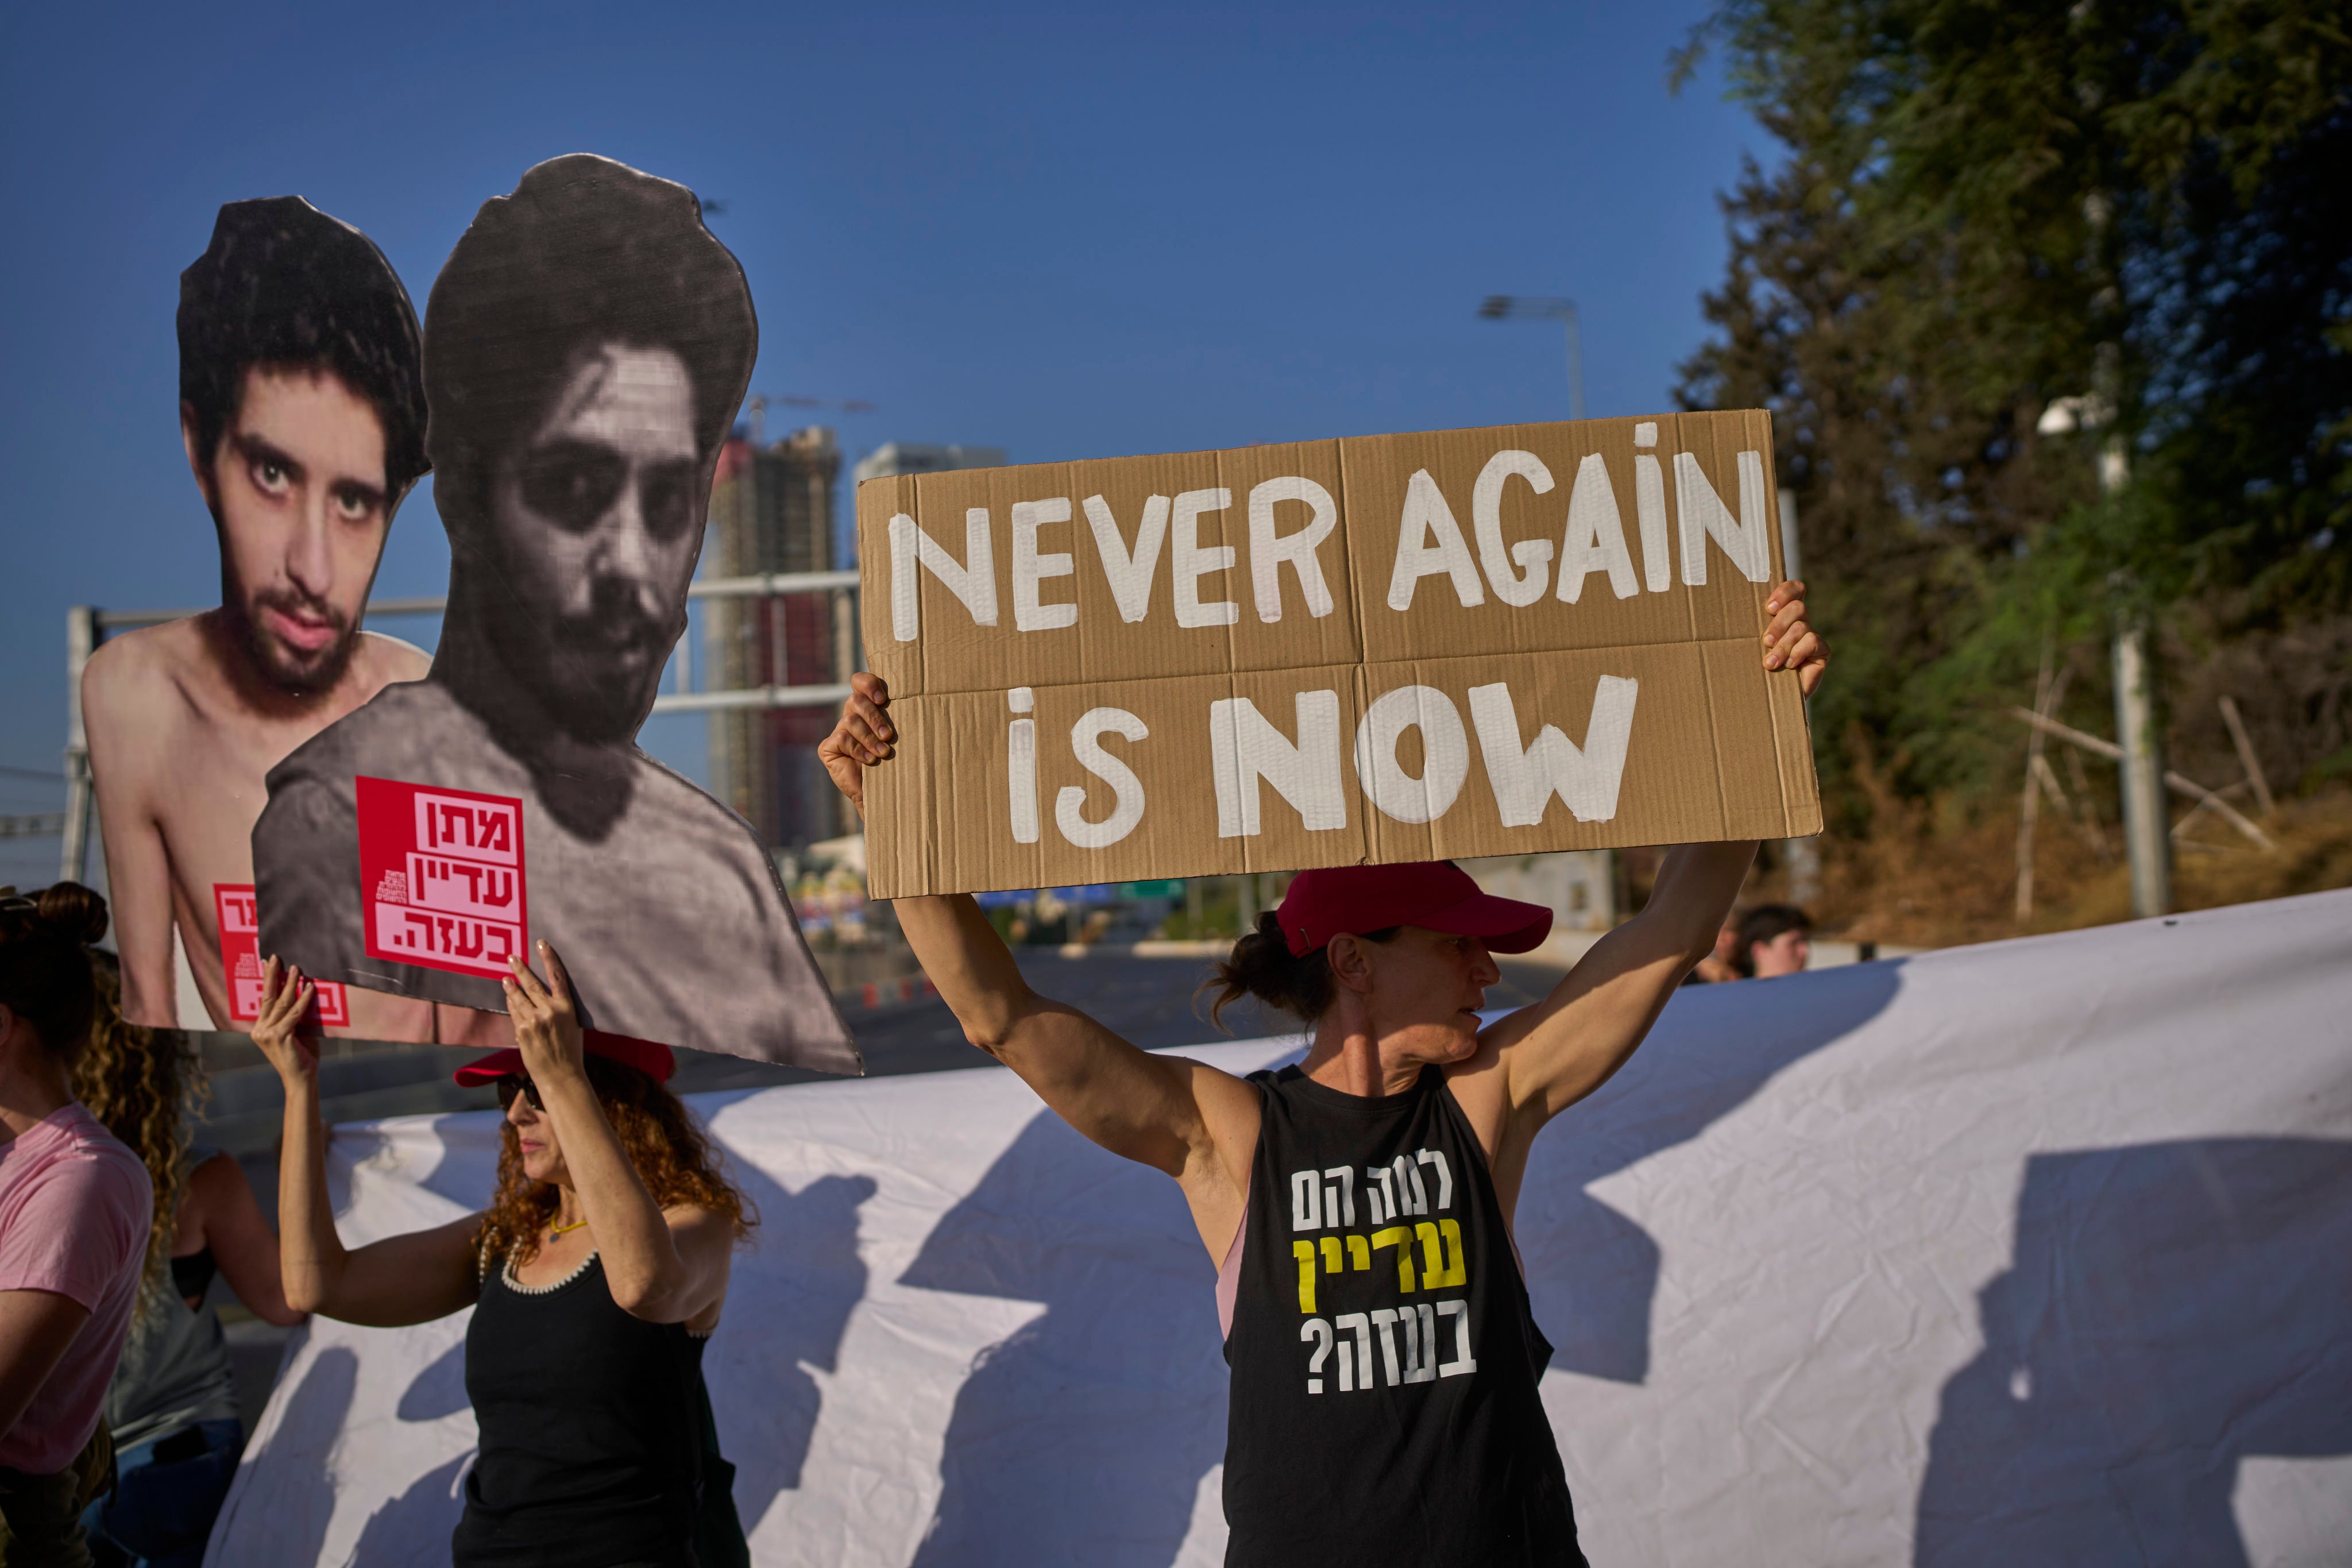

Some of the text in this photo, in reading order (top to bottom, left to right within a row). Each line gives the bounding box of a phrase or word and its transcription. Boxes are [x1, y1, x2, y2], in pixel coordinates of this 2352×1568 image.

[887, 476, 1338, 642] NEVER
[1210, 674, 1639, 839] NOW
[427, 802, 511, 852] מתן
[414, 858, 513, 907] עדיין
[393, 912, 514, 963] בעזה.
[1291, 1148, 1453, 1232] למה הם
[1292, 1218, 1467, 1314] עדיין
[1300, 1299, 1478, 1395] בעזה?
